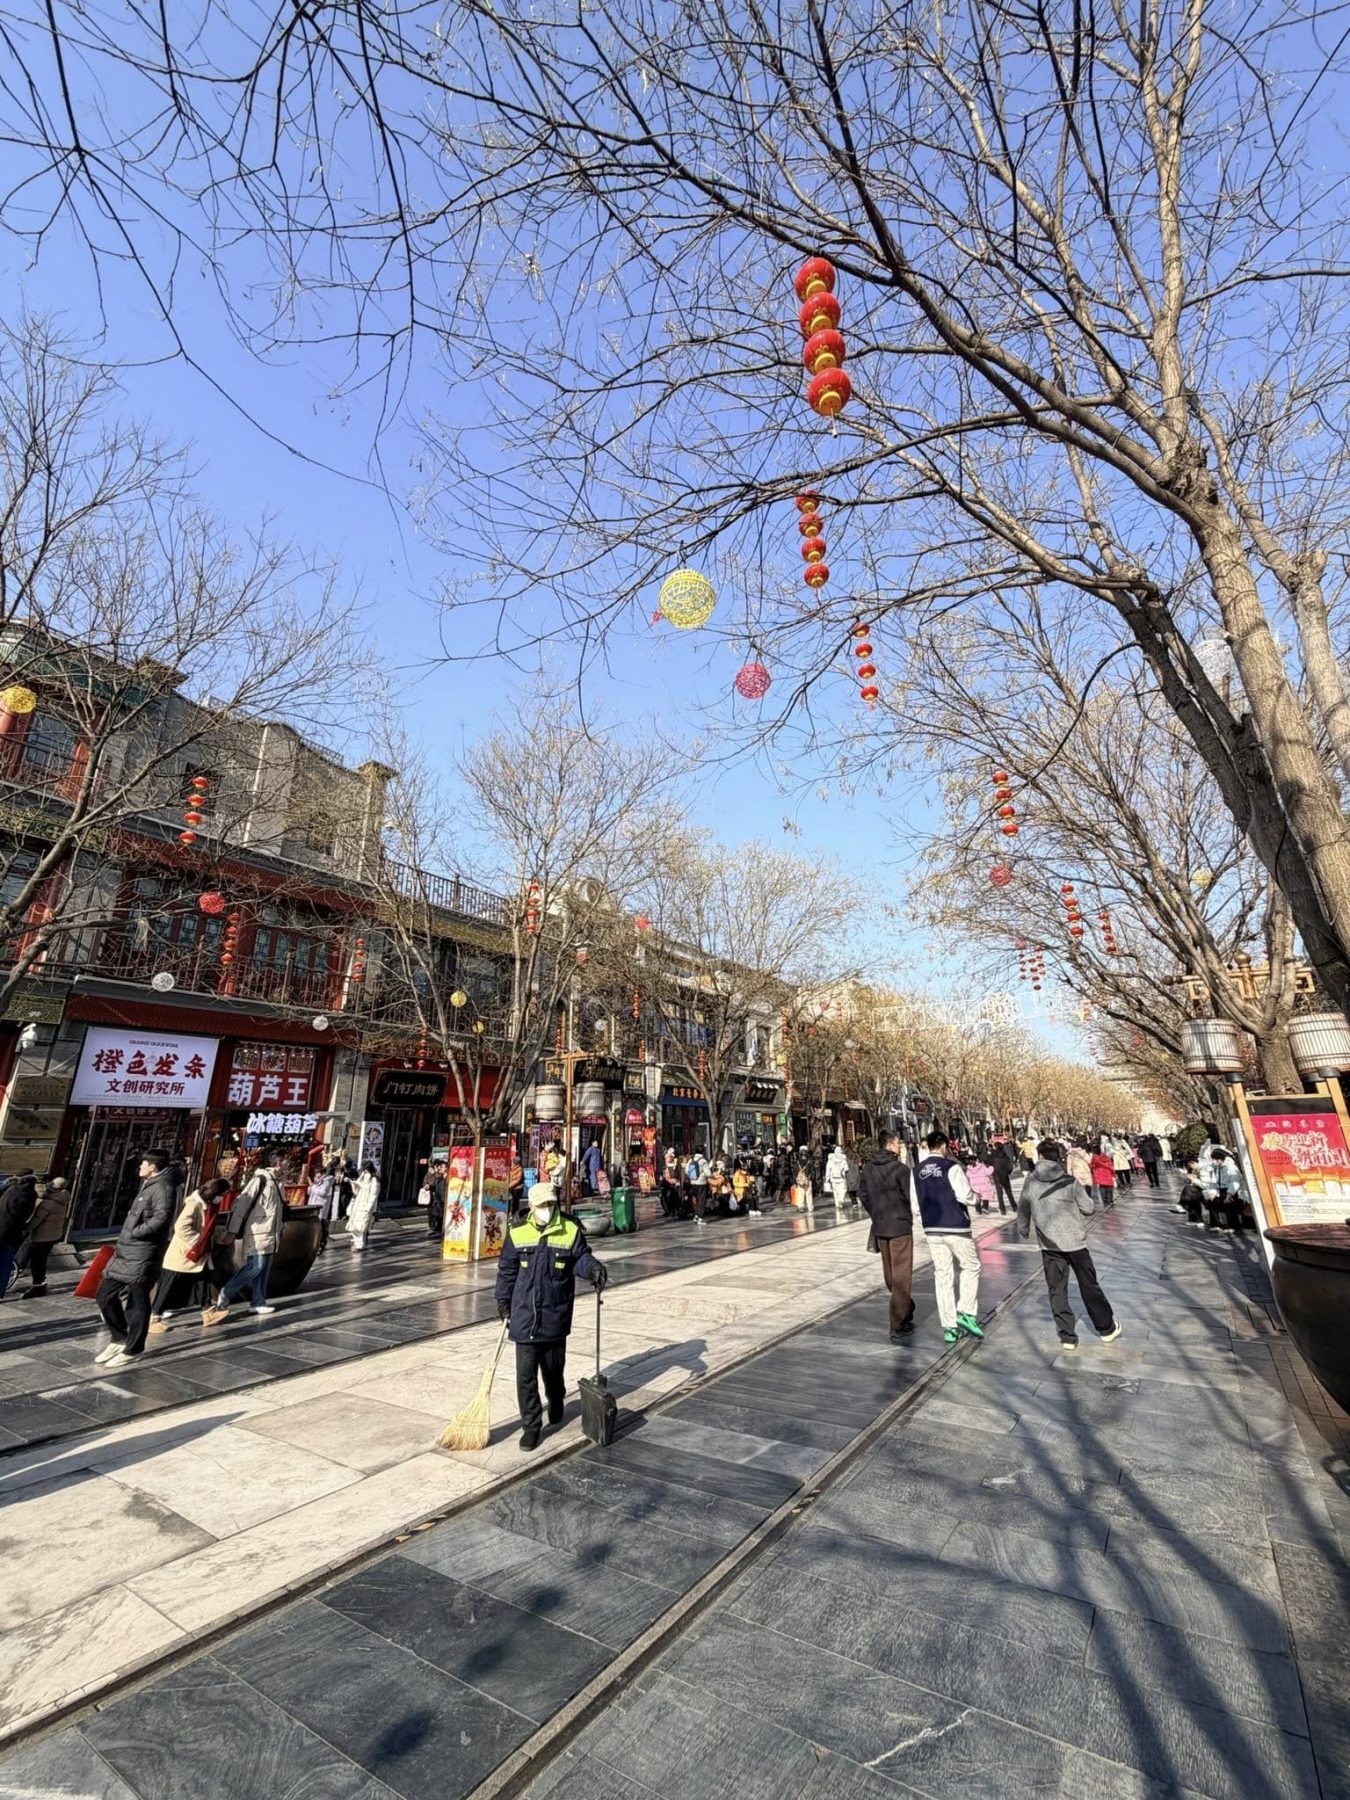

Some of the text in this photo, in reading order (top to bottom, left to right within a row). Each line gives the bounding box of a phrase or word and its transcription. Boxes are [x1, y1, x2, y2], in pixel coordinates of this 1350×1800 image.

[91, 1048, 207, 1079] 橙色发条
[105, 1078, 186, 1096] 文创研究所
[228, 1072, 308, 1106] 葫芦王
[383, 1081, 439, 1096] 门钉肉饼
[246, 1112, 320, 1134] 冰糖葫芦
